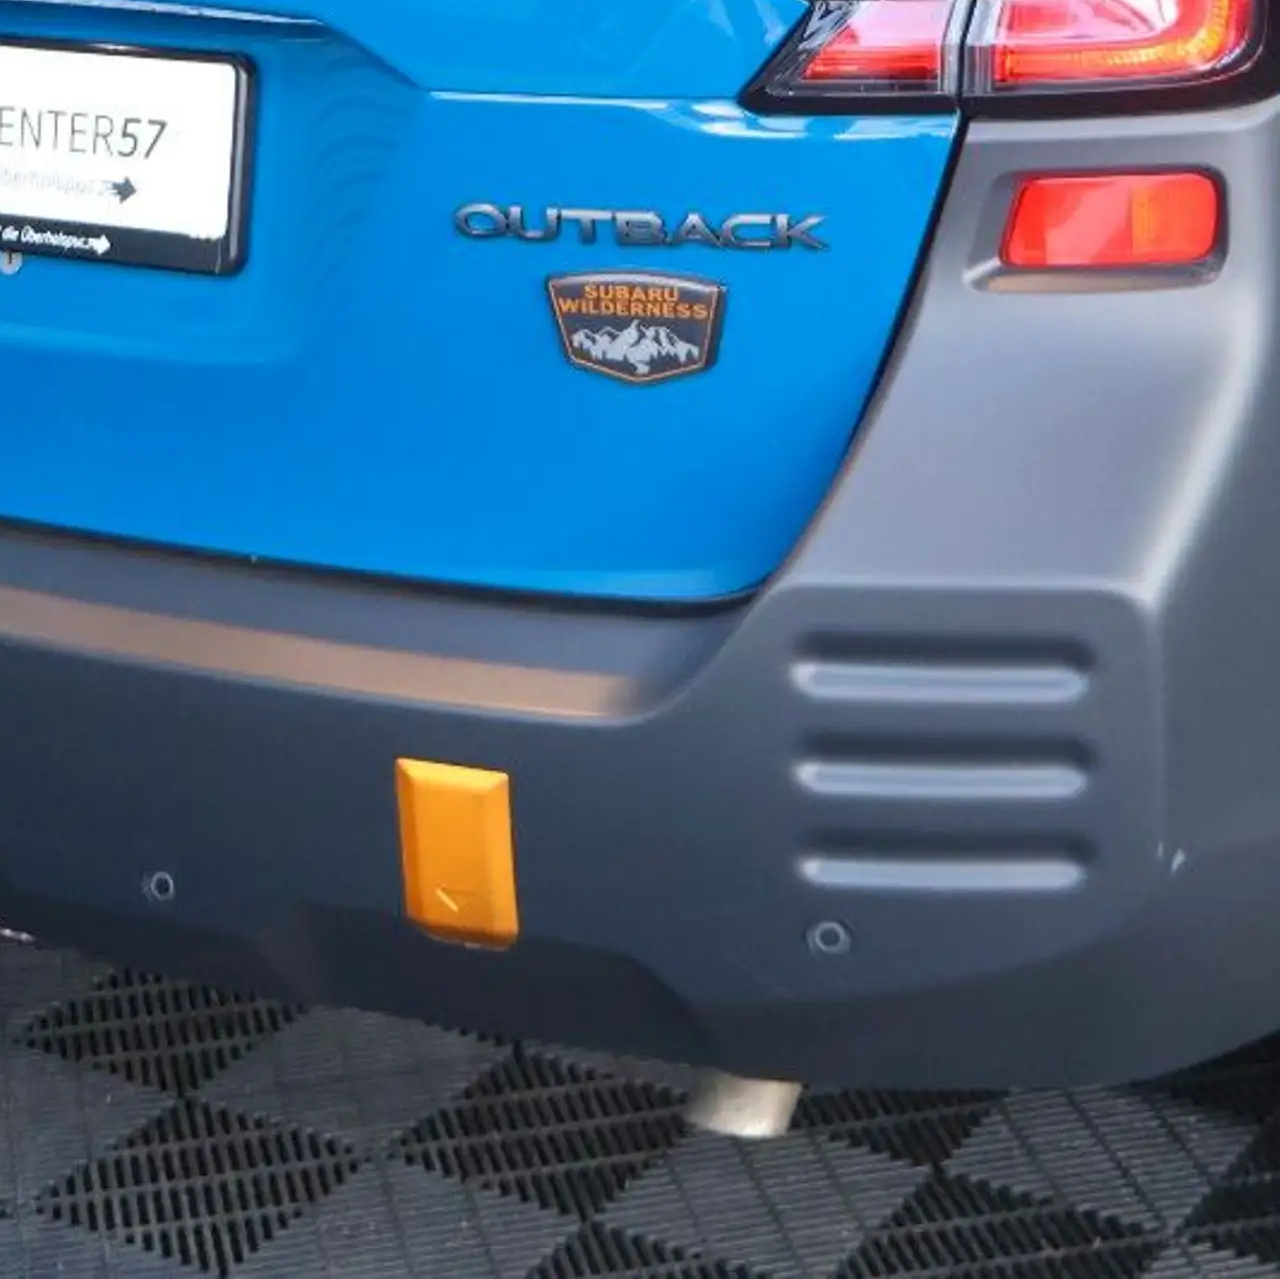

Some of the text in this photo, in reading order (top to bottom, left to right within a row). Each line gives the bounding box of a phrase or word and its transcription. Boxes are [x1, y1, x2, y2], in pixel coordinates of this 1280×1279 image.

[454, 202, 830, 252] OUTBACK
[583, 283, 679, 302] SUBARU
[558, 297, 709, 319] WILDERNESS
